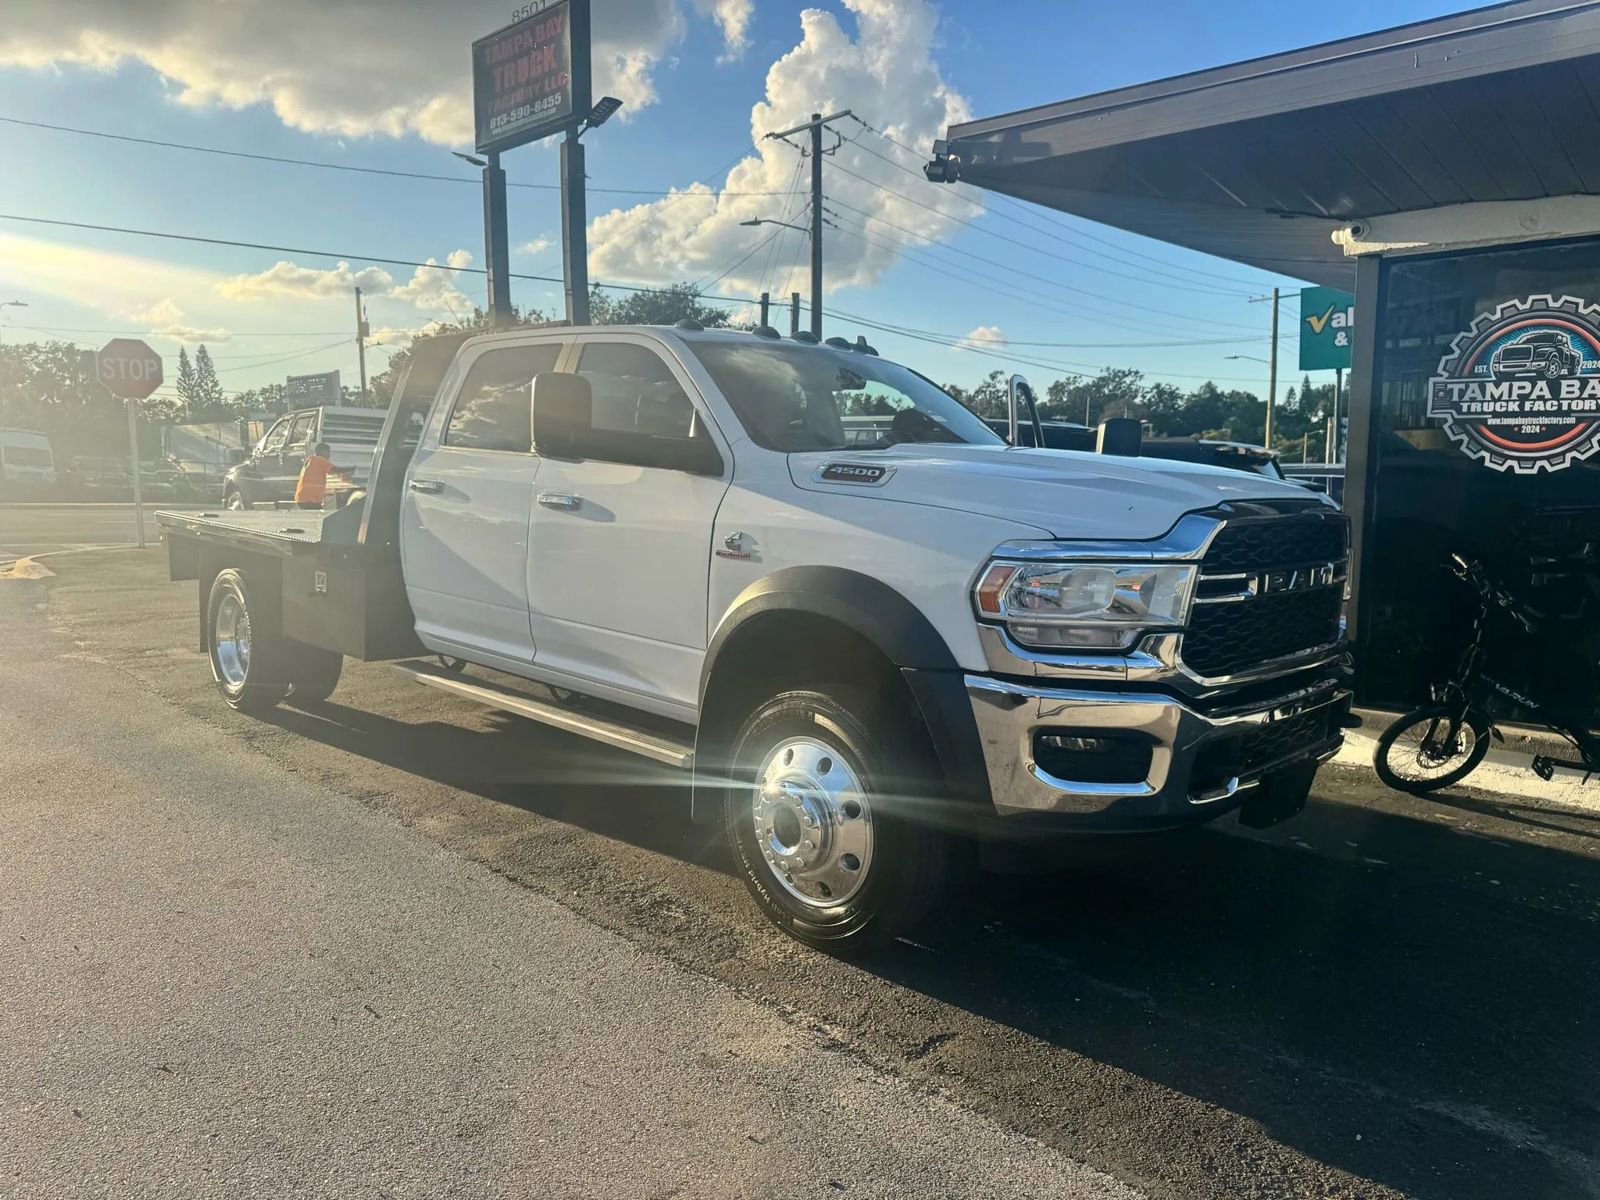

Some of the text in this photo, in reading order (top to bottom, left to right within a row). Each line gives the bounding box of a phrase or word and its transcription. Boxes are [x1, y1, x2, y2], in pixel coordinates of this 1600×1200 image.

[511, 0, 547, 24] 8501
[102, 358, 158, 380] STOP
[1474, 364, 1489, 374] EST.
[1447, 380, 1553, 402] TAMPA
[1460, 399, 1600, 413] TRUCK FACTOR
[1487, 416, 1576, 426] www.tampabaytruckfactory.com
[1521, 425, 1540, 434] 2024
[830, 466, 881, 478] 4500
